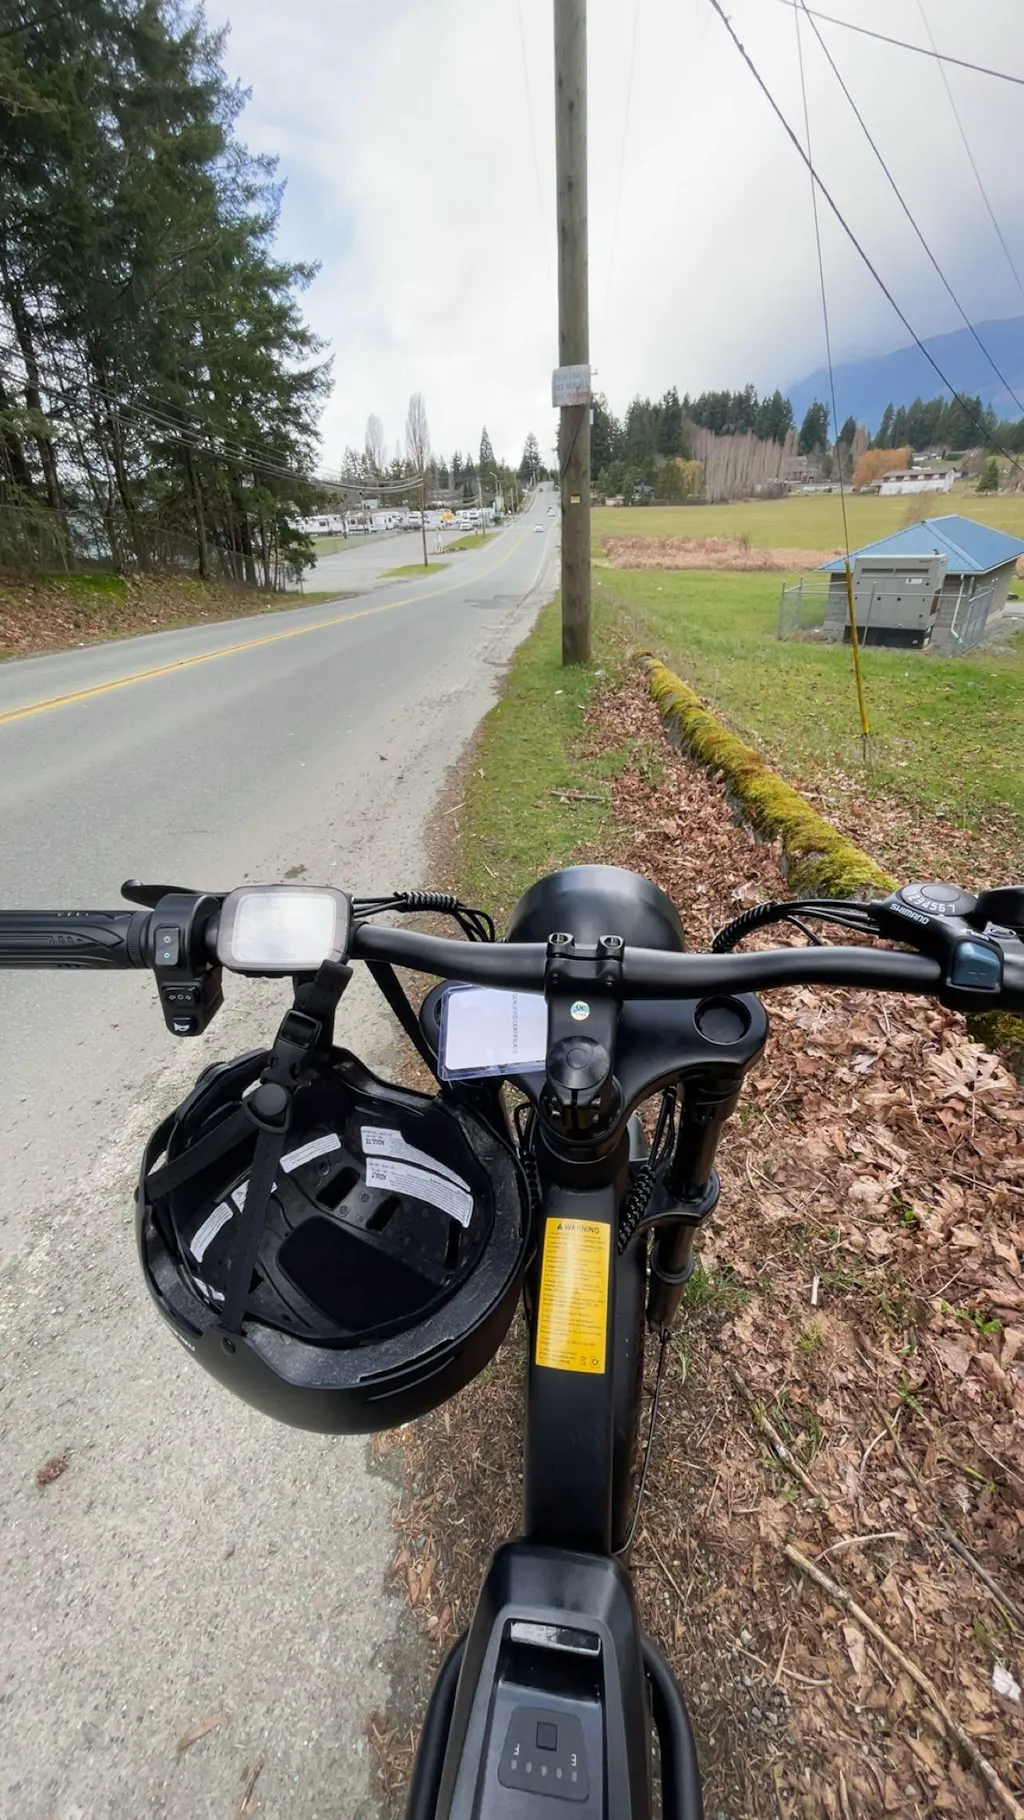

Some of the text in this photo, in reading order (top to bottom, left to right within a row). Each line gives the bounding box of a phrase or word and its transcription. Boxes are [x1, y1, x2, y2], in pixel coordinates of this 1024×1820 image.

[889, 903, 930, 925] SHIMANO
[365, 1137, 385, 1146] ADULTE
[371, 1171, 387, 1181] ADULT
[564, 1223, 600, 1234] WARNING
